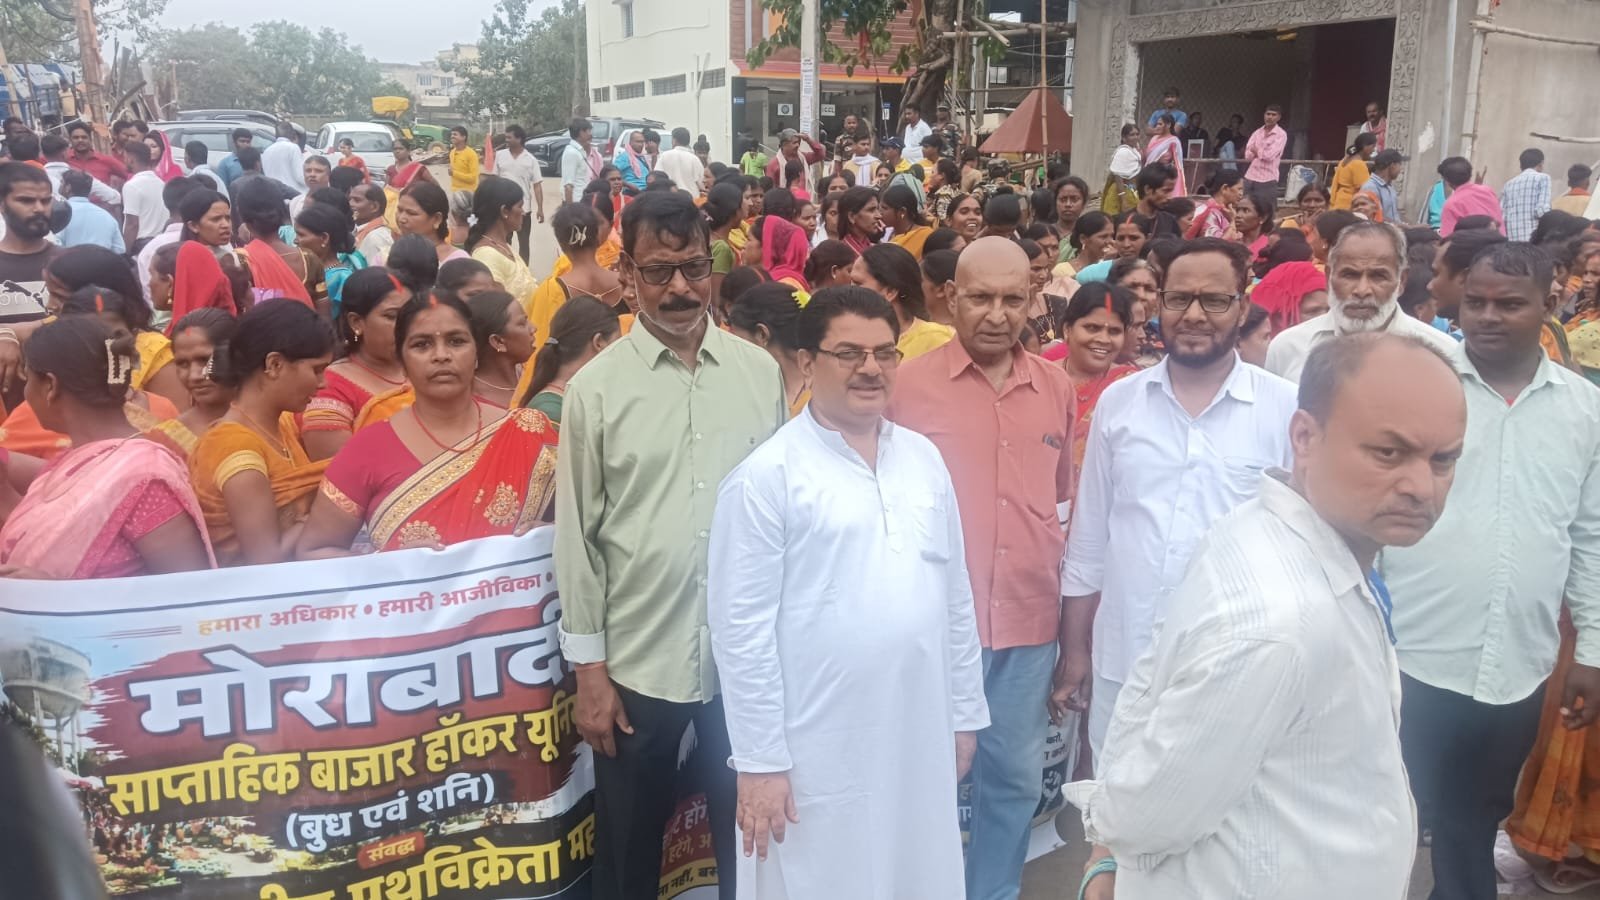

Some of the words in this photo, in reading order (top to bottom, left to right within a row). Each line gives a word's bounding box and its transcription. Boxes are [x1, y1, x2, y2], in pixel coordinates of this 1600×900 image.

[198, 614, 262, 636] हमारा
[270, 605, 358, 627] अधिकार
[378, 591, 434, 617] हमारी
[440, 574, 541, 607] आजीविका
[106, 743, 301, 816] साप्ताहिक
[307, 738, 416, 792] बाजार
[422, 712, 518, 773] हॉकर
[286, 812, 352, 853] (बुध
[359, 790, 409, 828] एवं
[417, 773, 495, 813] शनि)
[346, 836, 561, 900] पथविक्रेता
